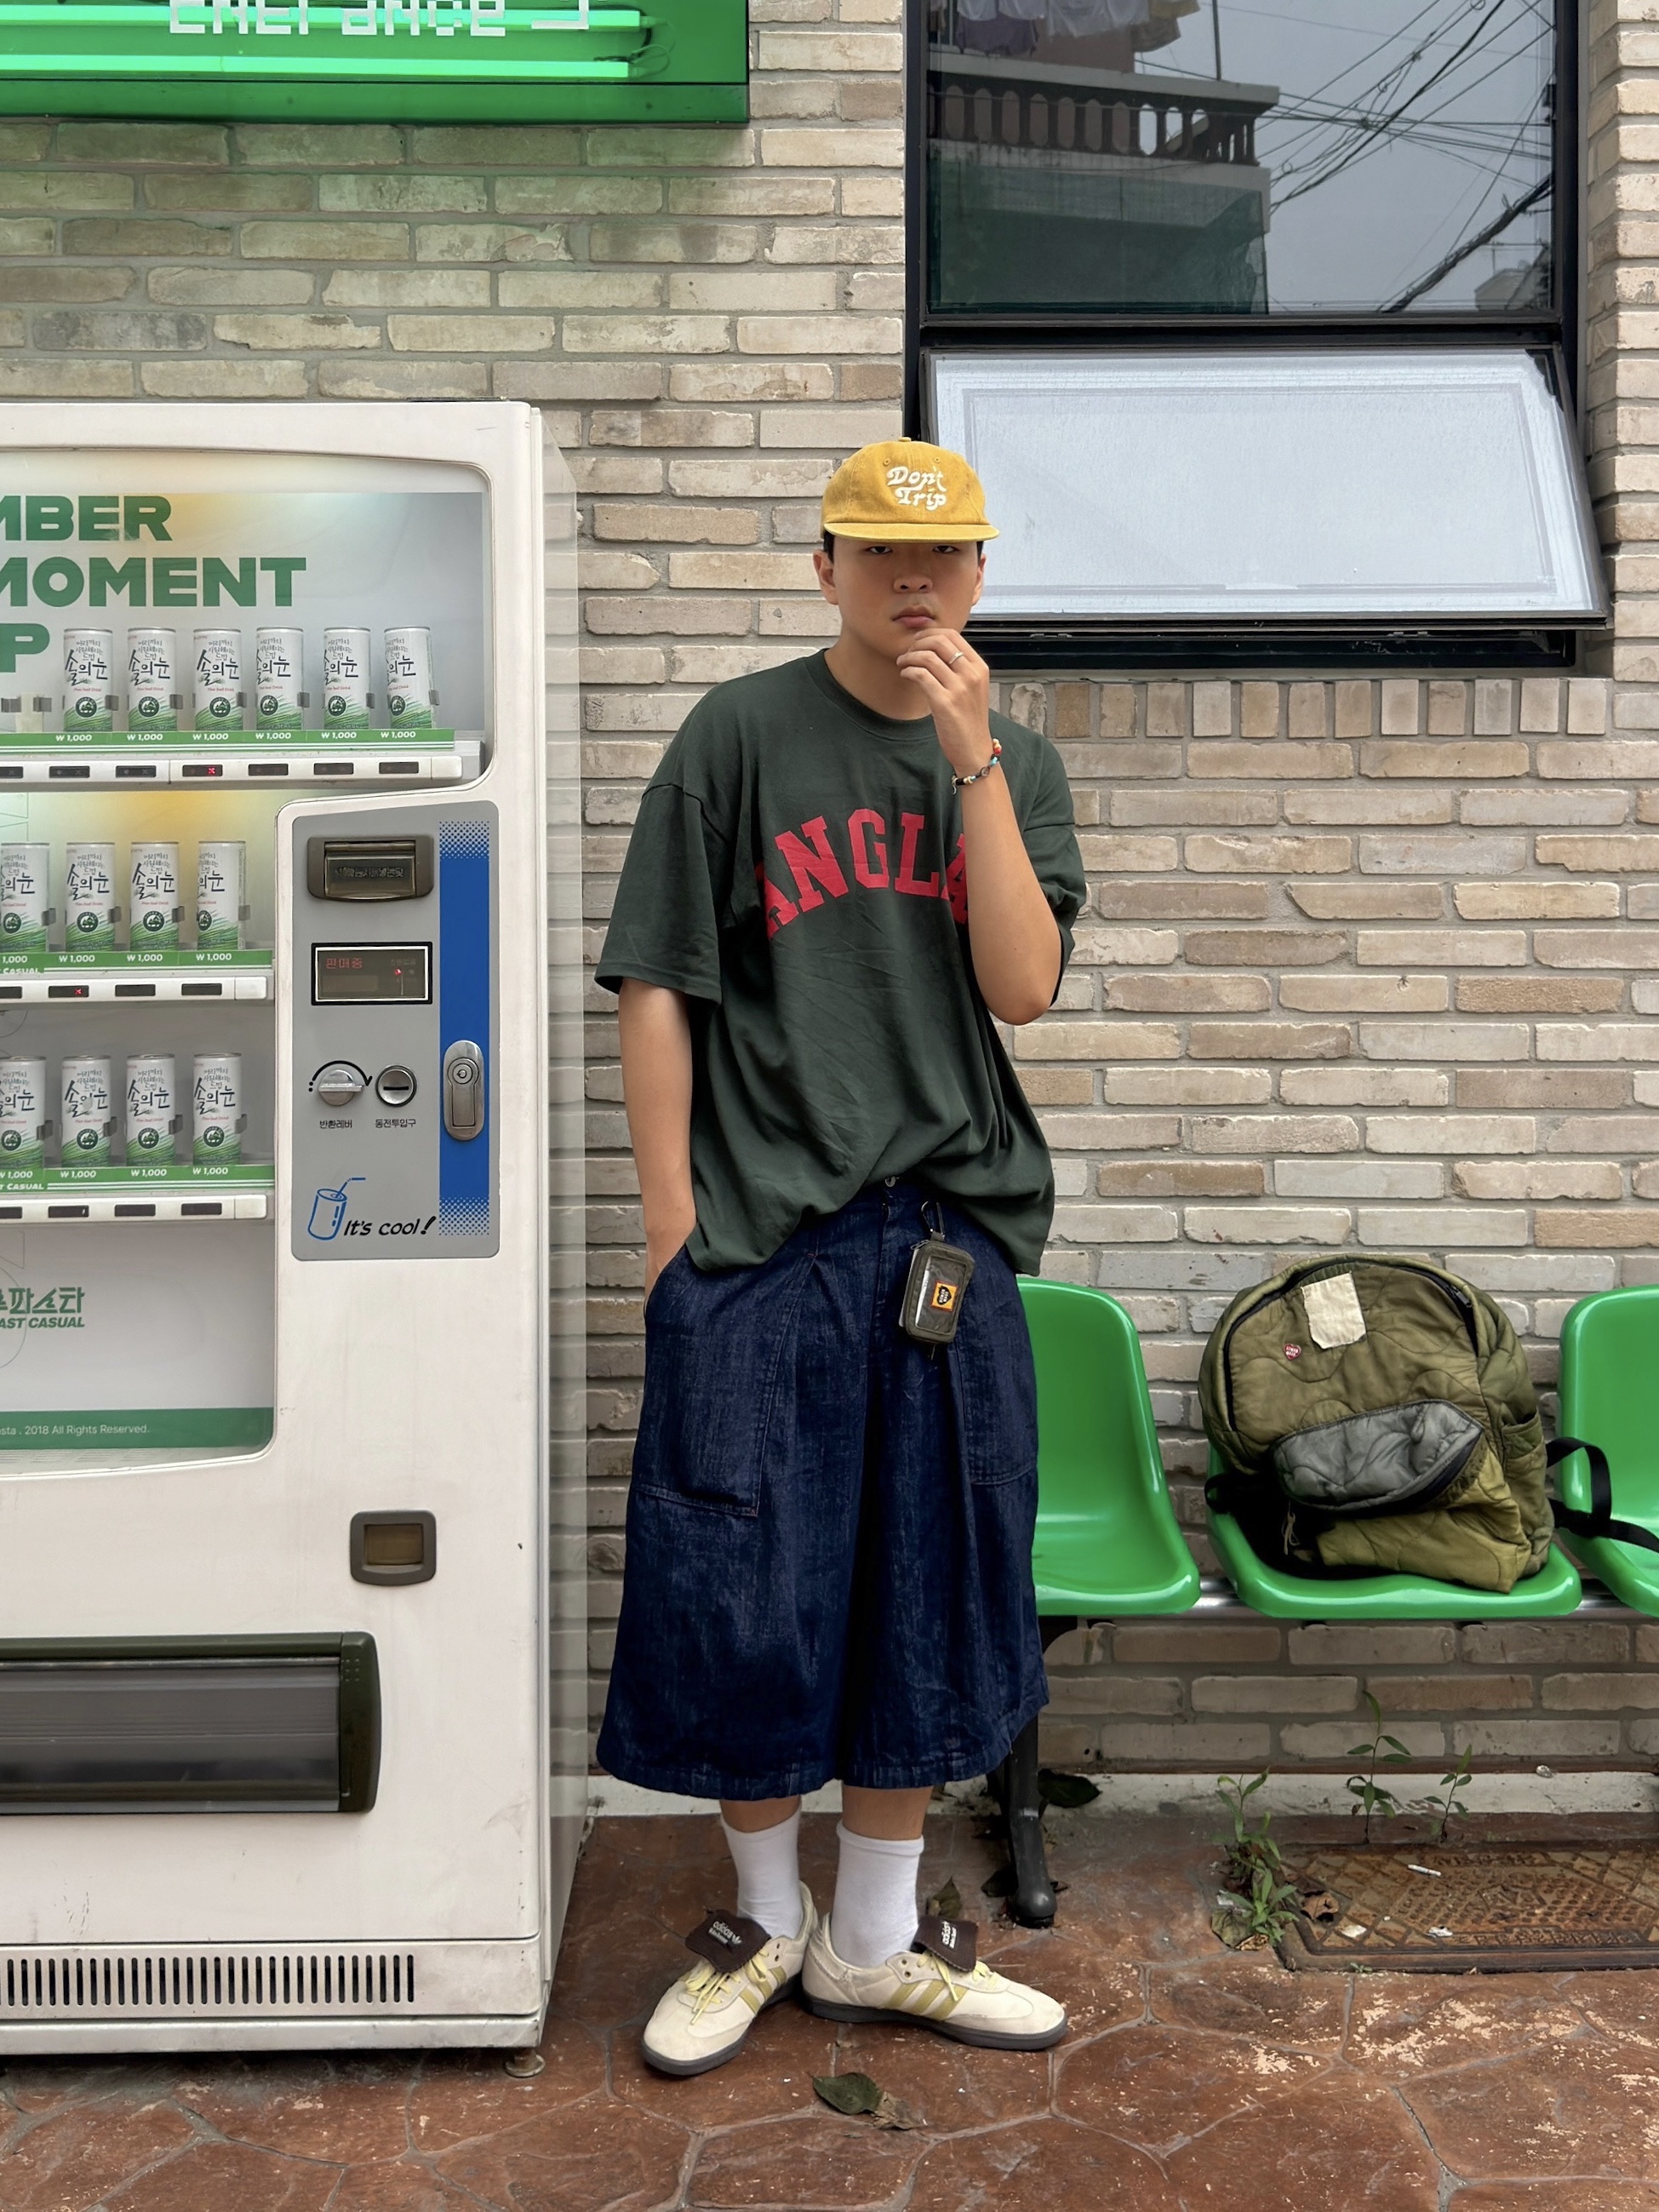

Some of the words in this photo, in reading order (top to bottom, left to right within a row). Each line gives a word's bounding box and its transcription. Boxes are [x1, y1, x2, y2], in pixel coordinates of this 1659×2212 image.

[887, 466, 947, 491] Don't
[895, 487, 947, 511] Trip
[65, 649, 108, 686] 솔의눈
[129, 649, 170, 686] 솔의눈
[197, 649, 240, 686] 솔의눈
[386, 654, 416, 685] 의눈
[66, 734, 92, 742] 1,000
[392, 731, 416, 739] 1,000
[67, 864, 110, 901] 솔의눈
[132, 862, 175, 900] 솔의눈
[198, 870, 225, 892] 의눈
[2, 955, 28, 964] 1,000
[70, 954, 95, 963] 1,000
[137, 954, 163, 962] 1,000
[207, 953, 232, 961] 1,000
[128, 1080, 169, 1116] 솔의눈
[194, 1077, 236, 1115] 솔의눈
[319, 1120, 352, 1129] 반환레버
[375, 1119, 416, 1128] 동전투입구
[8, 1171, 33, 1179] 1,000
[141, 1169, 168, 1178] 1,000
[203, 1167, 228, 1176] 1,000
[344, 1219, 373, 1236] It's
[28, 1316, 85, 1328] CASUAL
[25, 1425, 49, 1436] 2018
[52, 1424, 64, 1435] All
[66, 1424, 97, 1436] Rights
[100, 1424, 150, 1434] Reserved.
